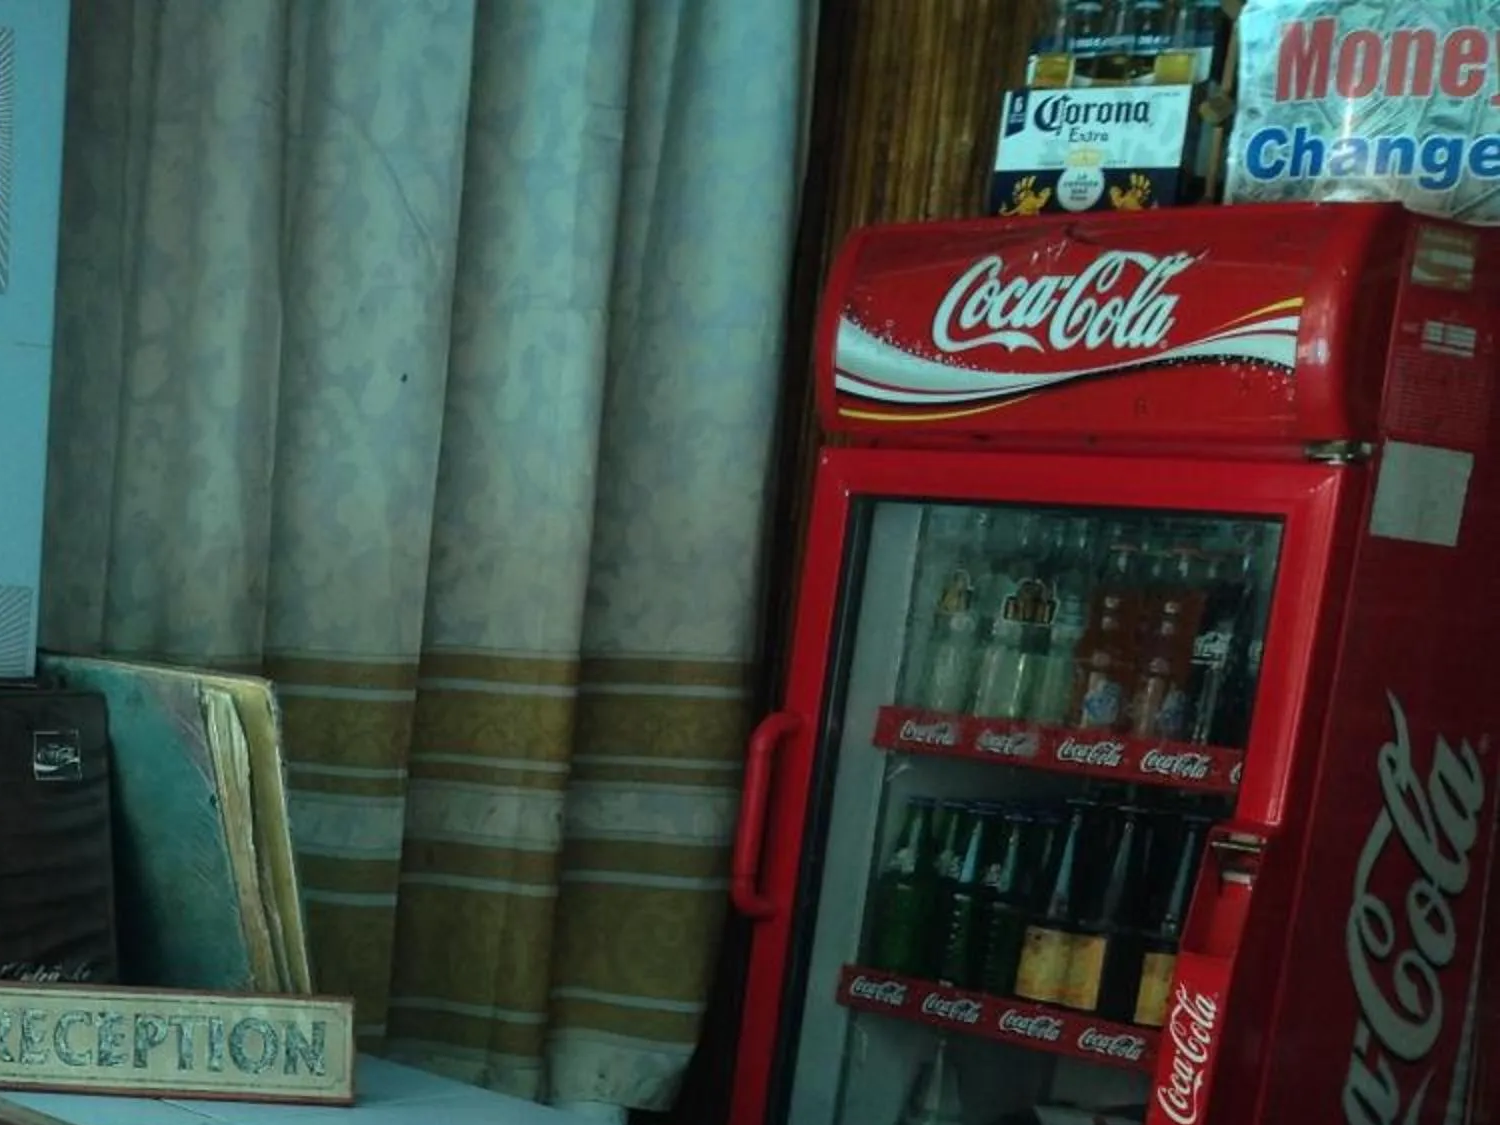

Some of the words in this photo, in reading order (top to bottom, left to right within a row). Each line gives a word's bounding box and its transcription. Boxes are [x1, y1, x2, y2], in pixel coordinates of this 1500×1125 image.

[1275, 16, 1500, 108] Mone
[1033, 94, 1151, 136] Corona
[1067, 126, 1110, 143] Extra
[932, 250, 1198, 354] Coca-Cola
